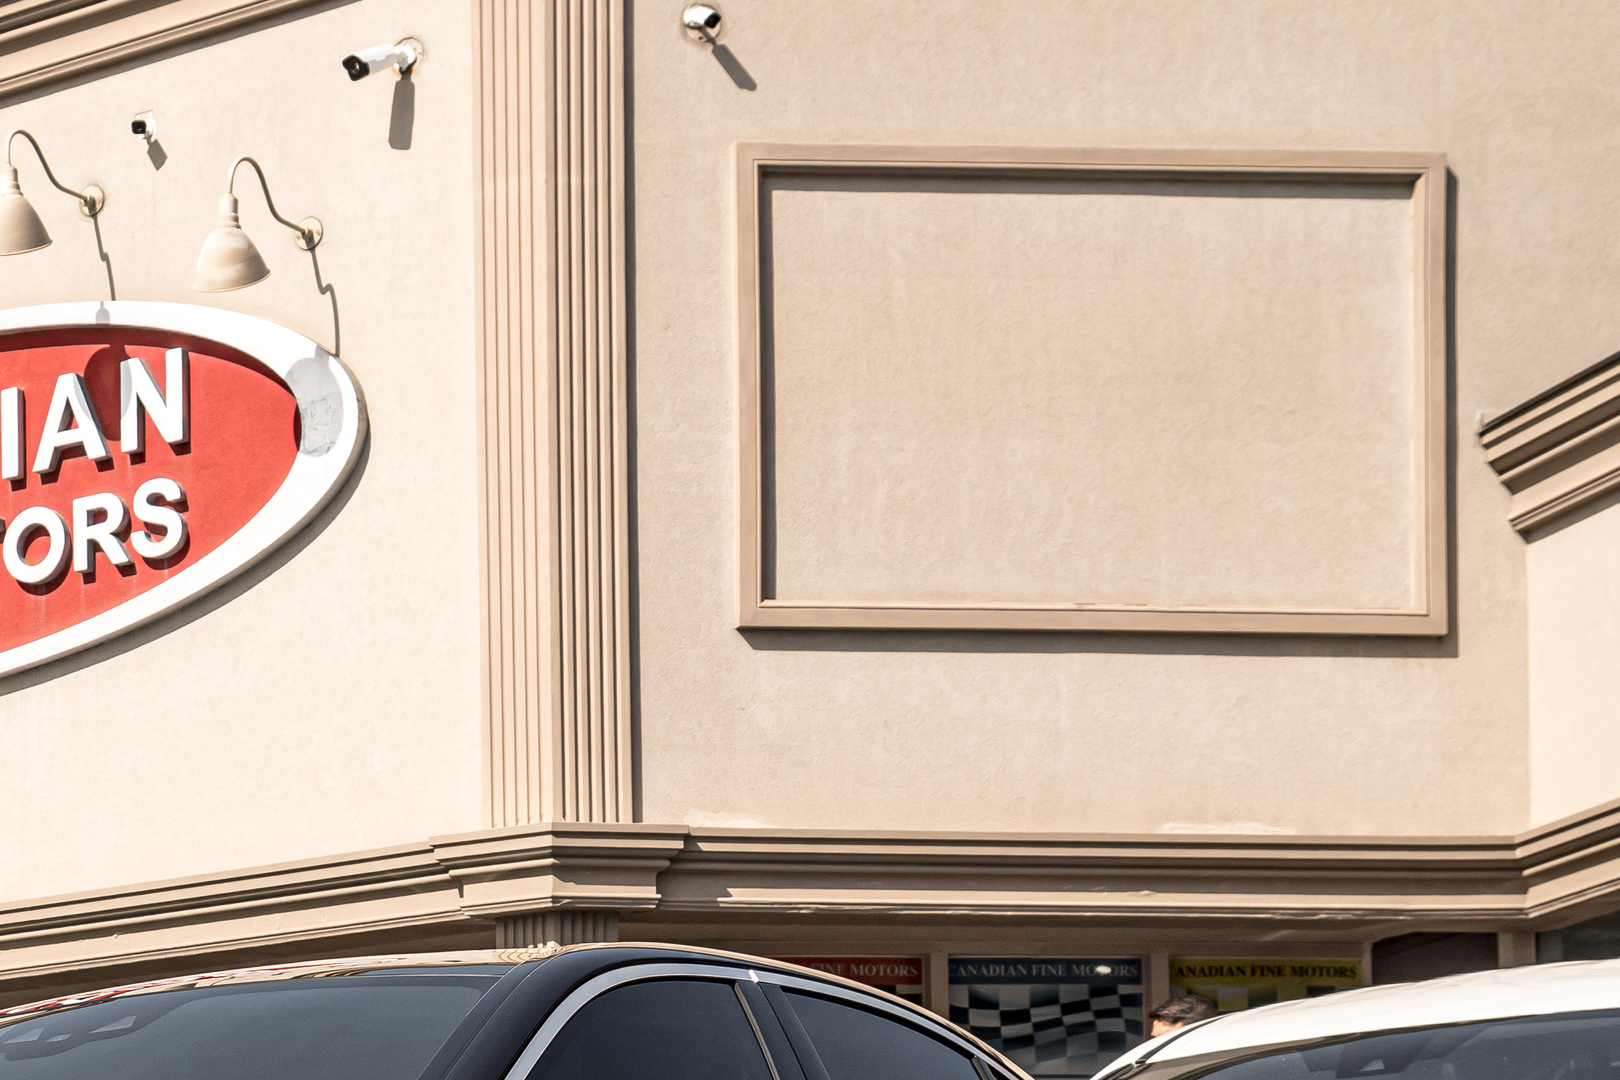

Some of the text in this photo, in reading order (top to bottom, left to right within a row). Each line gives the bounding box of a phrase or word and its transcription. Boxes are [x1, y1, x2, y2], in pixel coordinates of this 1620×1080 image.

[849, 963, 919, 977] MOTORS
[949, 964, 1140, 978] CANADIAN FINE MOORS
[1250, 964, 1287, 978] FINE
[1289, 965, 1358, 979] MOTORS
